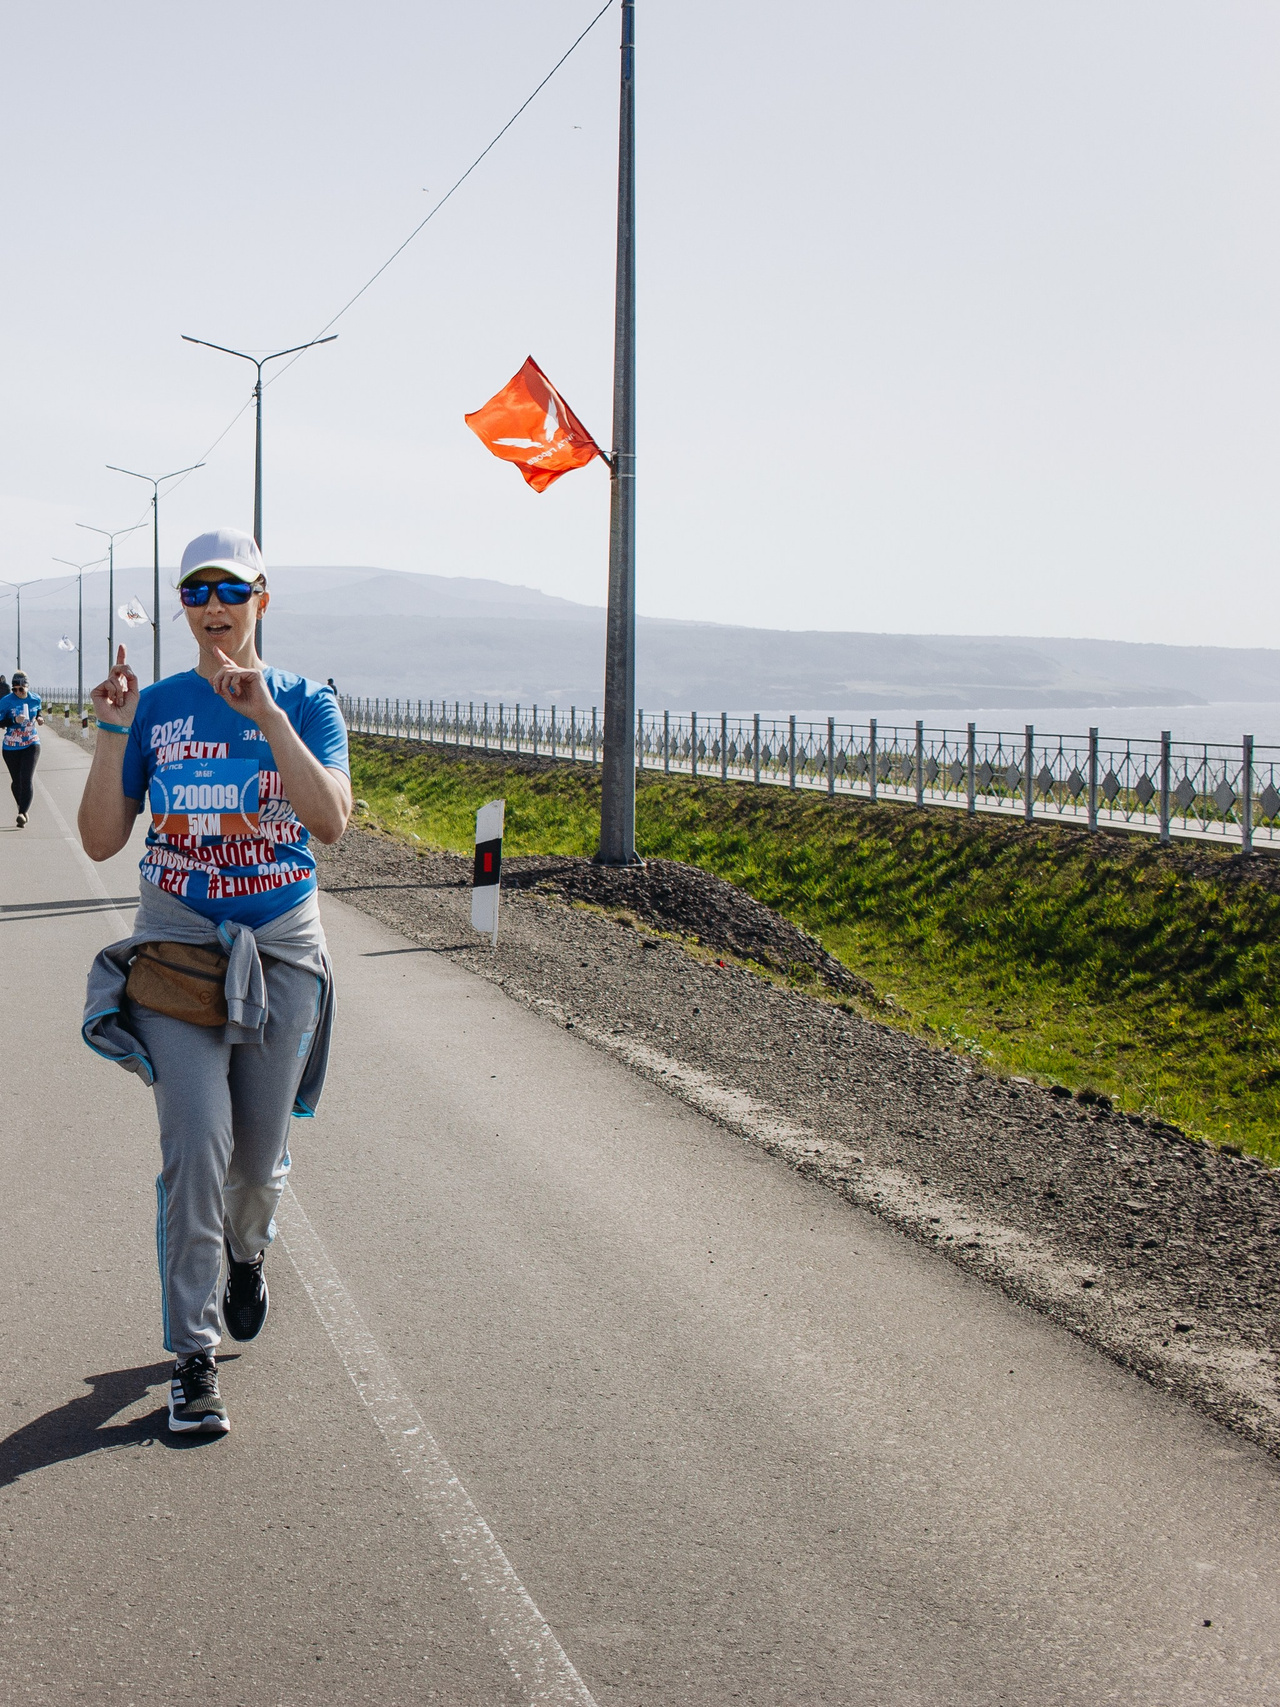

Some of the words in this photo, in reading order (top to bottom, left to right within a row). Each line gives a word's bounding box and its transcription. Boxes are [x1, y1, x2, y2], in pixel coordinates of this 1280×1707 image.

[150, 715, 195, 748] 2024
[168, 763, 184, 771] ПСБ
[172, 784, 239, 810] 20009
